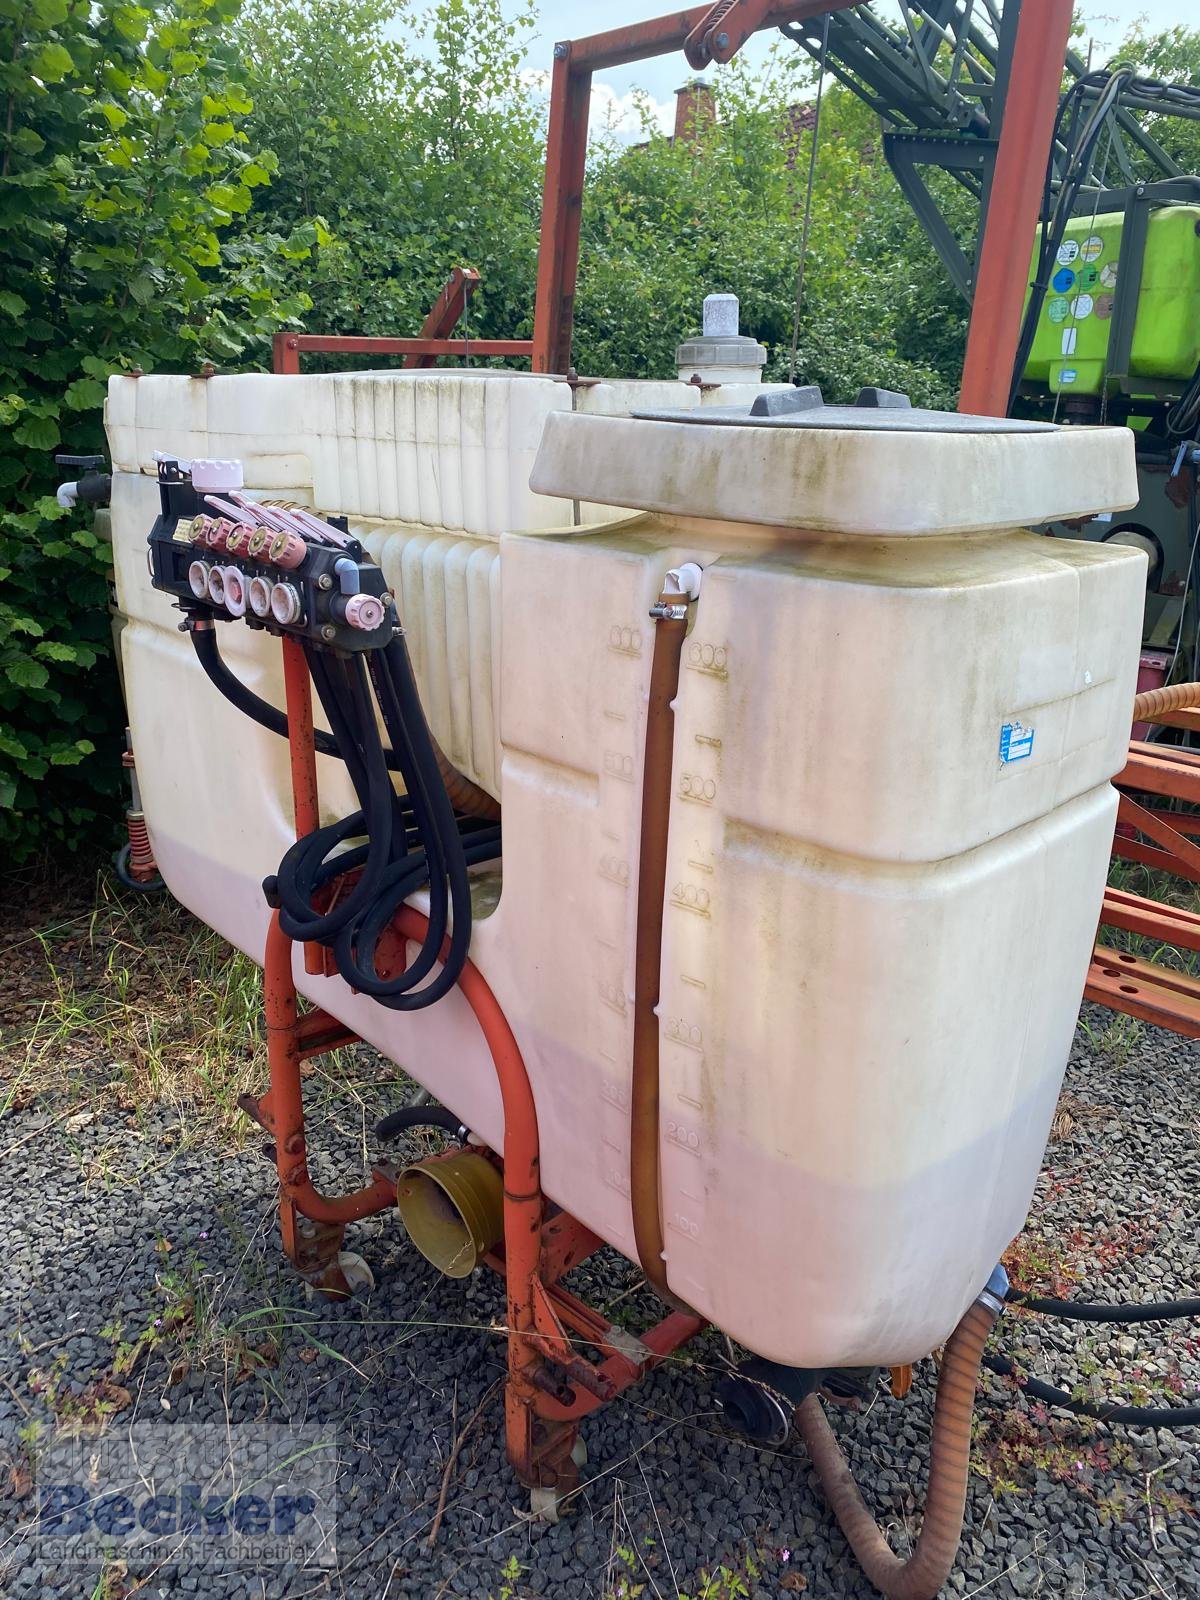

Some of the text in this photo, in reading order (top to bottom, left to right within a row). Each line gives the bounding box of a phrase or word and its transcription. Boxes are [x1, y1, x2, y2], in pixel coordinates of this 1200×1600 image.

[680, 773, 716, 800] 500
[671, 881, 710, 910] 400
[667, 1015, 703, 1044] 300
[666, 1120, 699, 1148] 200
[673, 1211, 700, 1238] 100
